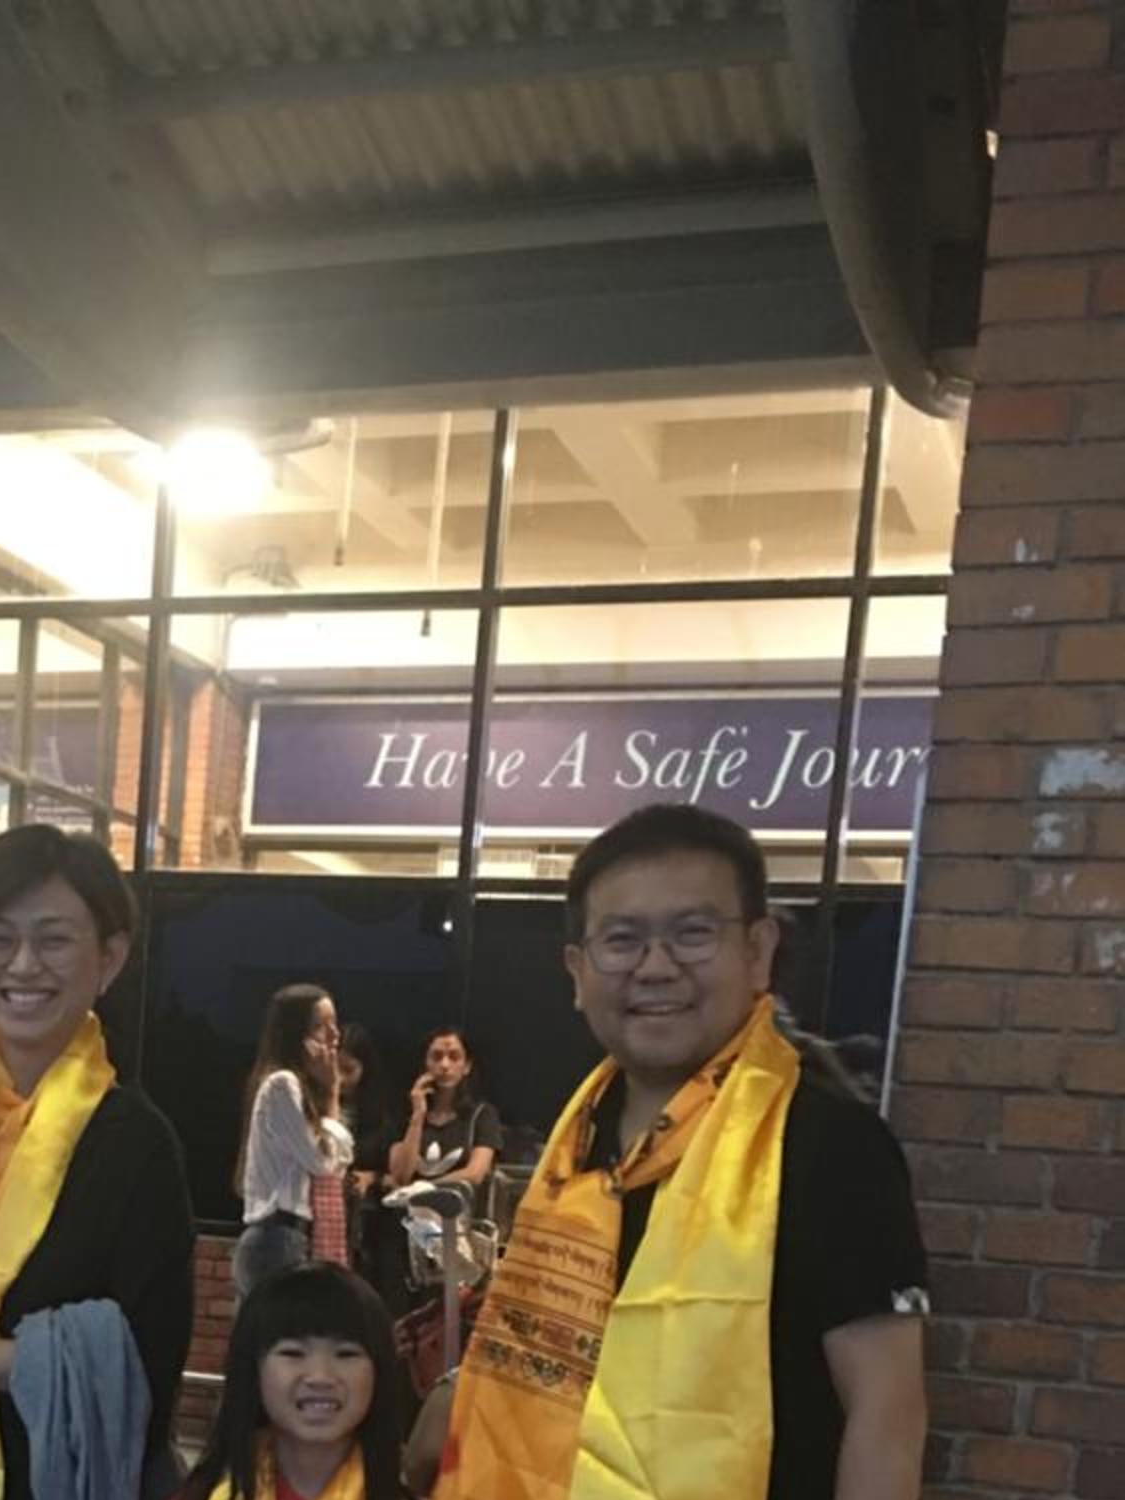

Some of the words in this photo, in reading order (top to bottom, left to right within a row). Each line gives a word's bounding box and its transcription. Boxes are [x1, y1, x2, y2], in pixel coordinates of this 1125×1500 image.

[539, 730, 588, 788] A
[614, 726, 750, 806] Safe
[750, 728, 931, 811] Jour
